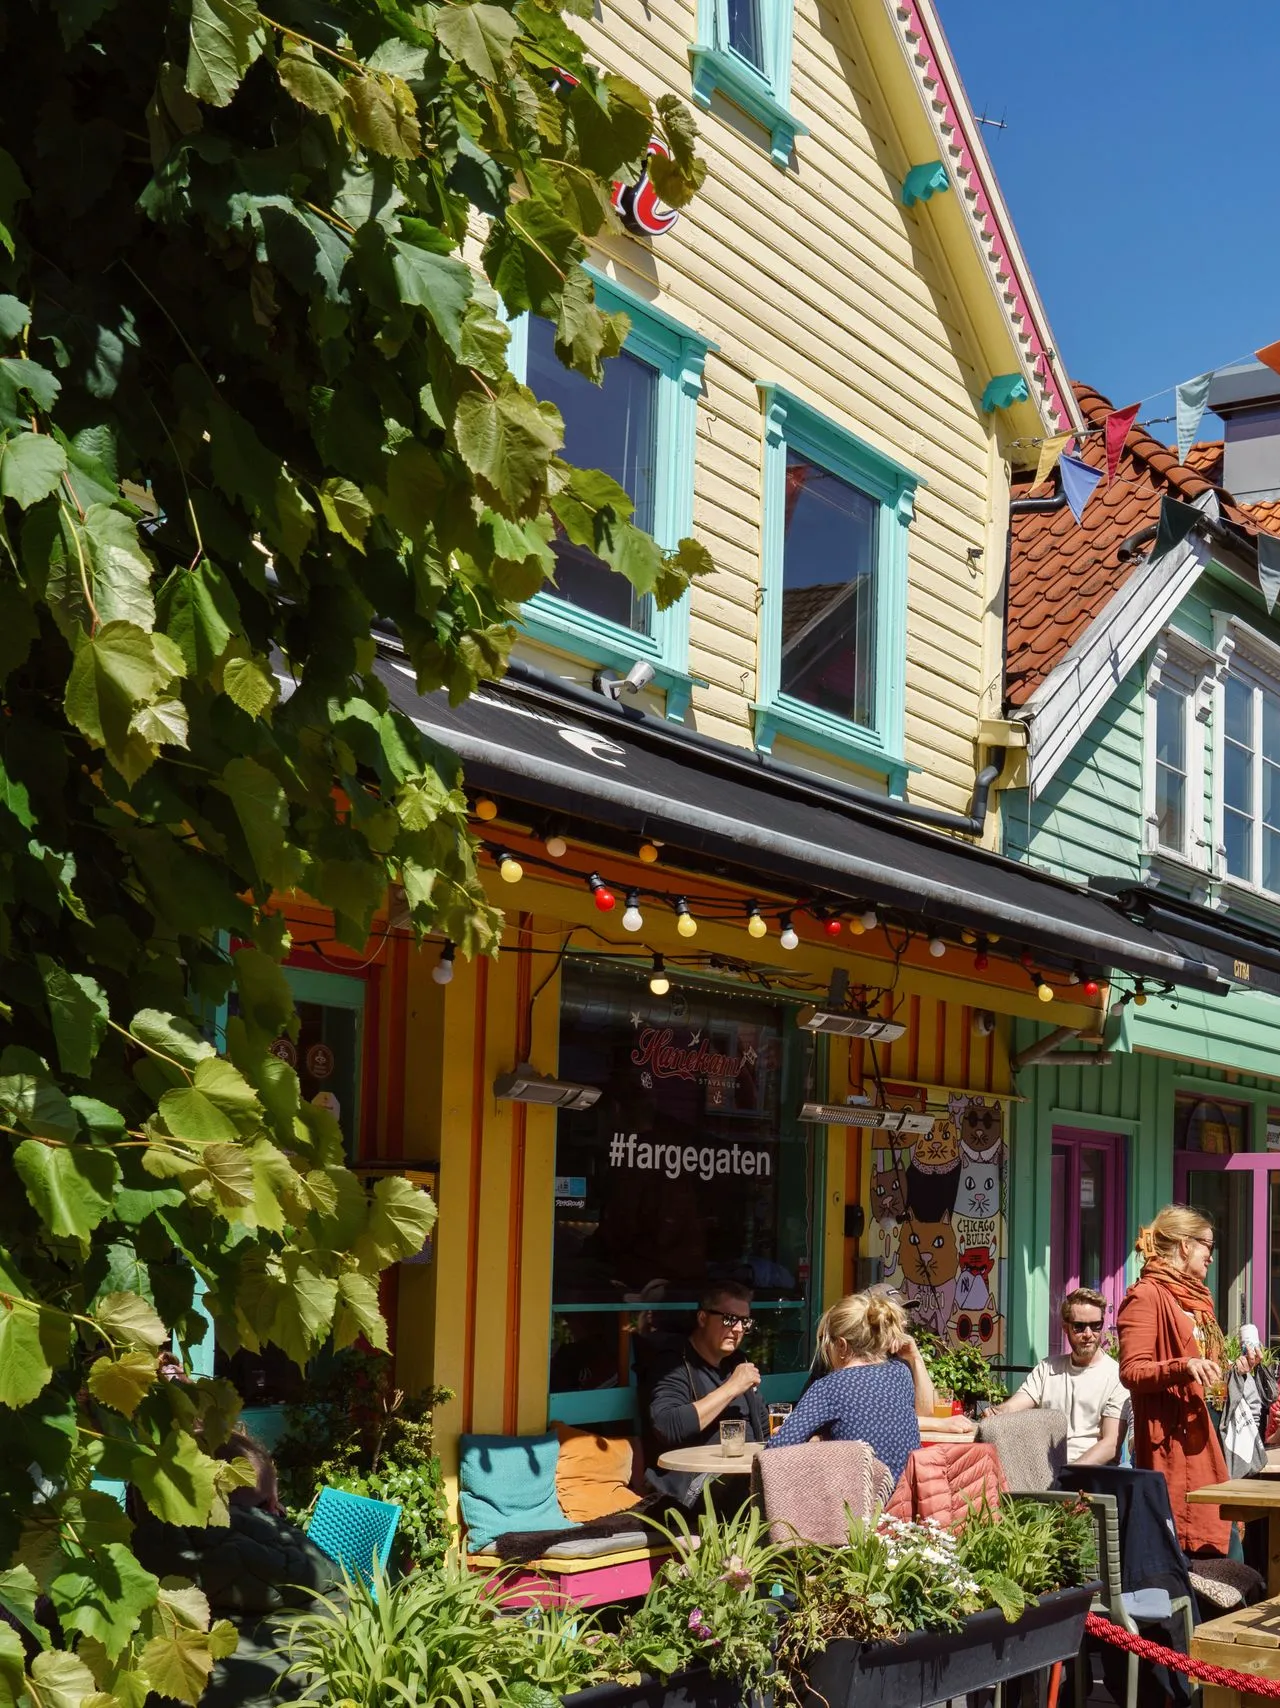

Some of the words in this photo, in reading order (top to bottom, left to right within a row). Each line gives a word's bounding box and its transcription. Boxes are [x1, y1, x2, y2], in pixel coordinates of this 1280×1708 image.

[698, 1078, 741, 1089] STAVANGER
[609, 1132, 771, 1181] #fargegaten
[957, 1218, 995, 1233] CHICAGO
[966, 1233, 990, 1246] BULLS
